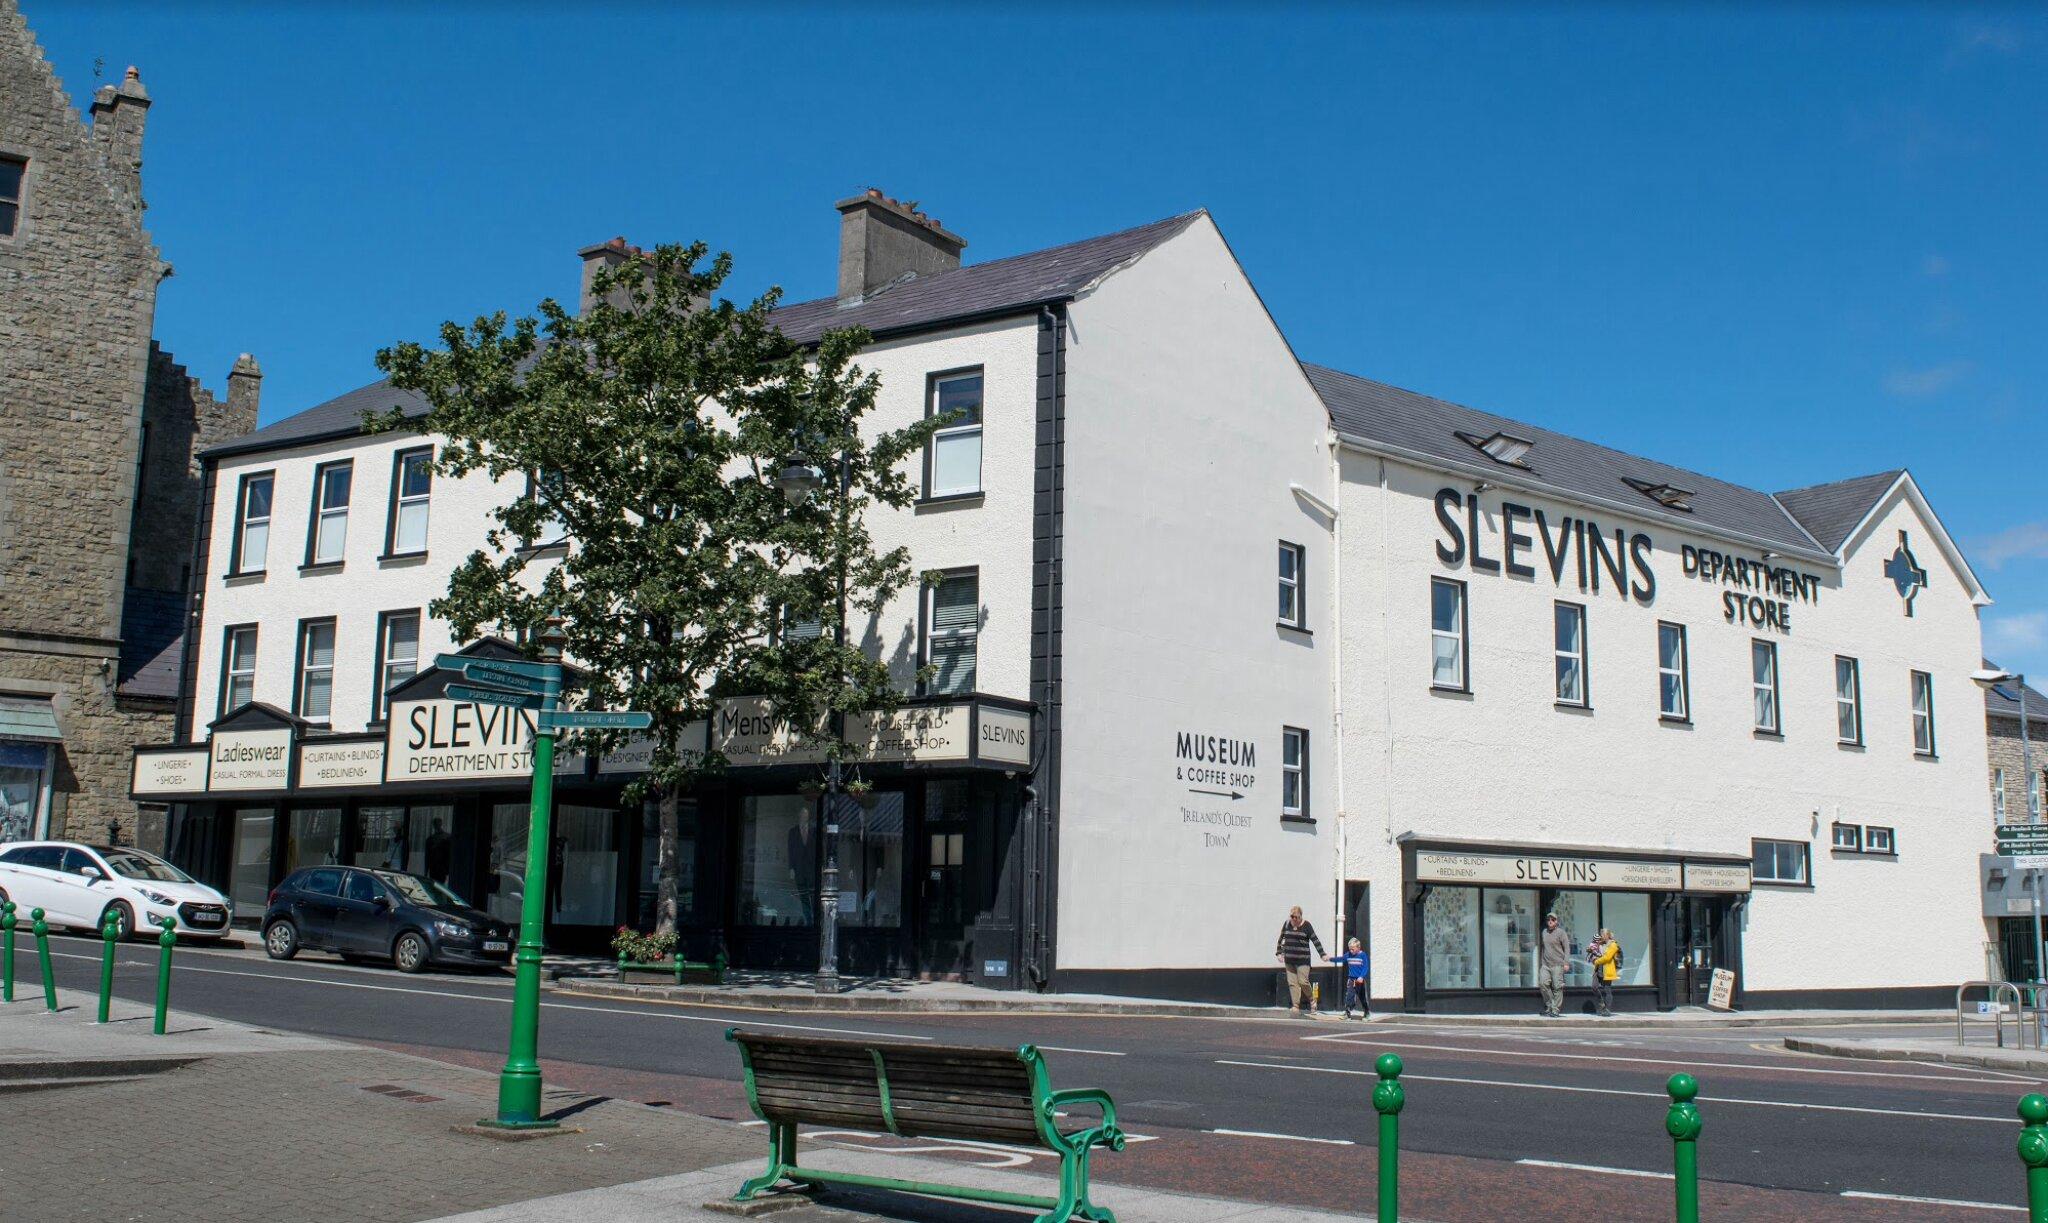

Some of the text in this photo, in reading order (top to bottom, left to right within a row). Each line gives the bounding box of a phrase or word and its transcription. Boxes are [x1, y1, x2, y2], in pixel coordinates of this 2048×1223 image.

[1434, 487, 1656, 603] SLEVINS
[1681, 544, 1821, 606] DEPARTMENT
[1723, 590, 1791, 630] STORE
[409, 702, 539, 751] SLEVIN
[869, 717, 943, 731] HOUSEHOLD
[982, 724, 1025, 746] SLEVINS
[868, 737, 945, 752] COFFEE SHOP
[1177, 732, 1255, 767] MUSEUM
[216, 742, 285, 763] Ladieswear
[307, 749, 380, 763] CURTAINS BLINDS
[606, 751, 649, 763] DESIGNER
[157, 760, 187, 771] LINGERIE
[409, 753, 508, 773] DEPARTMENT
[160, 776, 184, 785] SHOES
[267, 769, 286, 778] DRESS
[321, 768, 364, 779] BEDLINENS
[1177, 767, 1255, 787] & COFFEE SHOP
[1427, 855, 1486, 866] CURTAINS BLINDS
[1440, 868, 1473, 877] BEDLINENS
[1516, 859, 1598, 883] SLEVINS
[1628, 865, 1650, 873] LINGERIE
